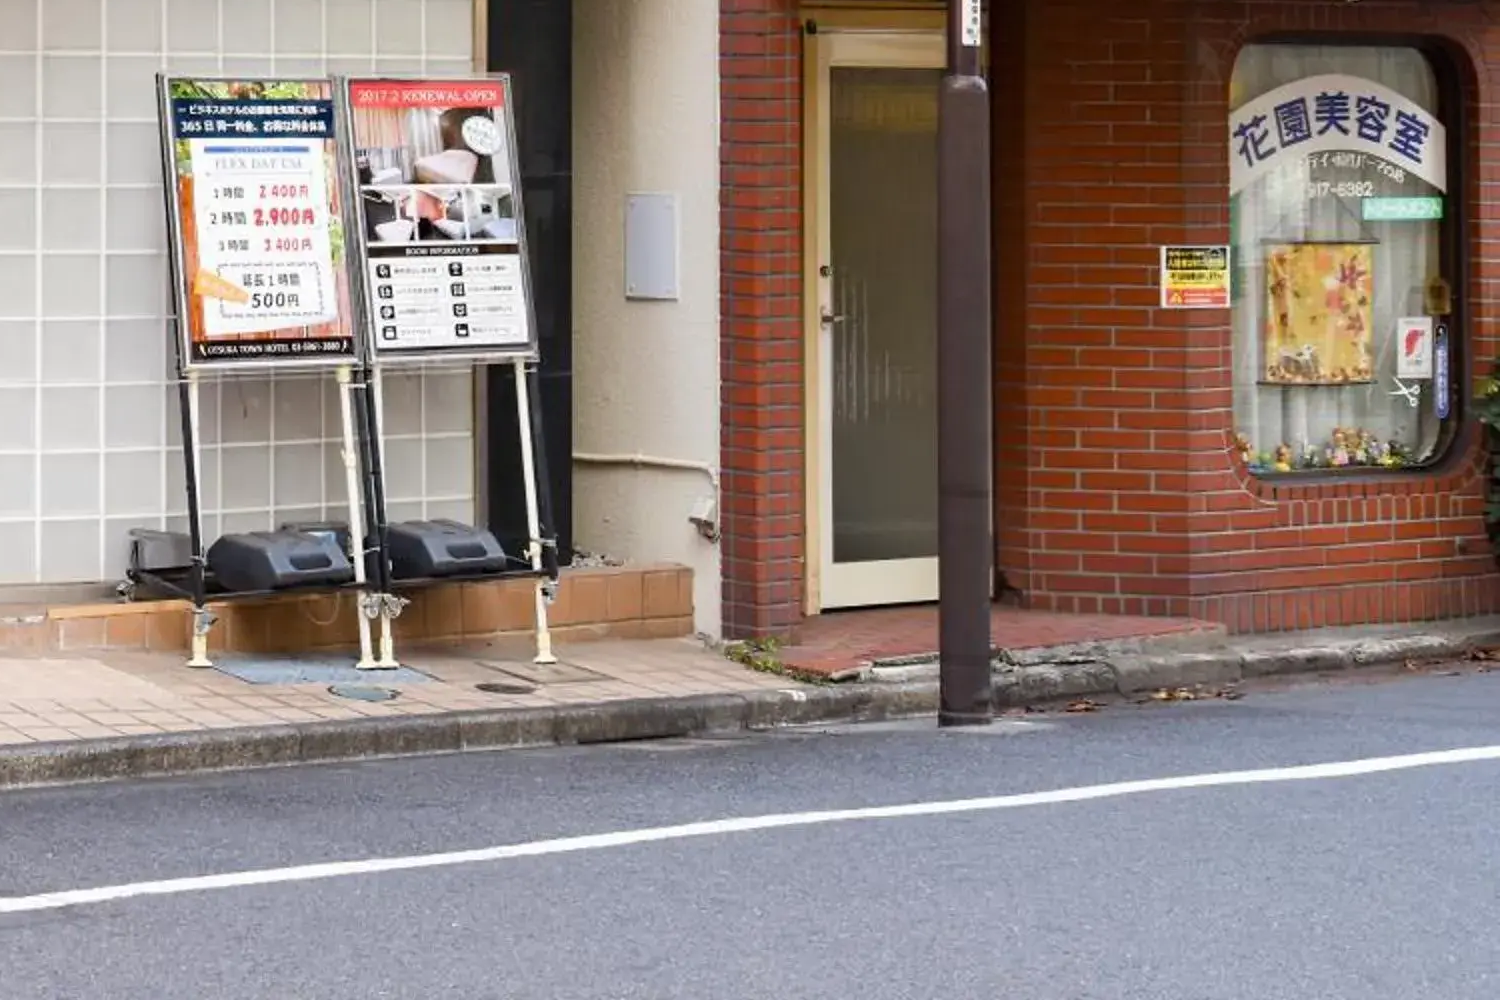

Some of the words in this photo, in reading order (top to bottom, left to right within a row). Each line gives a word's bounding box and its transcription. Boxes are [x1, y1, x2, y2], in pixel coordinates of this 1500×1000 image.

[1233, 91, 1430, 167] 花園美容室
[251, 293, 300, 309] 500円
